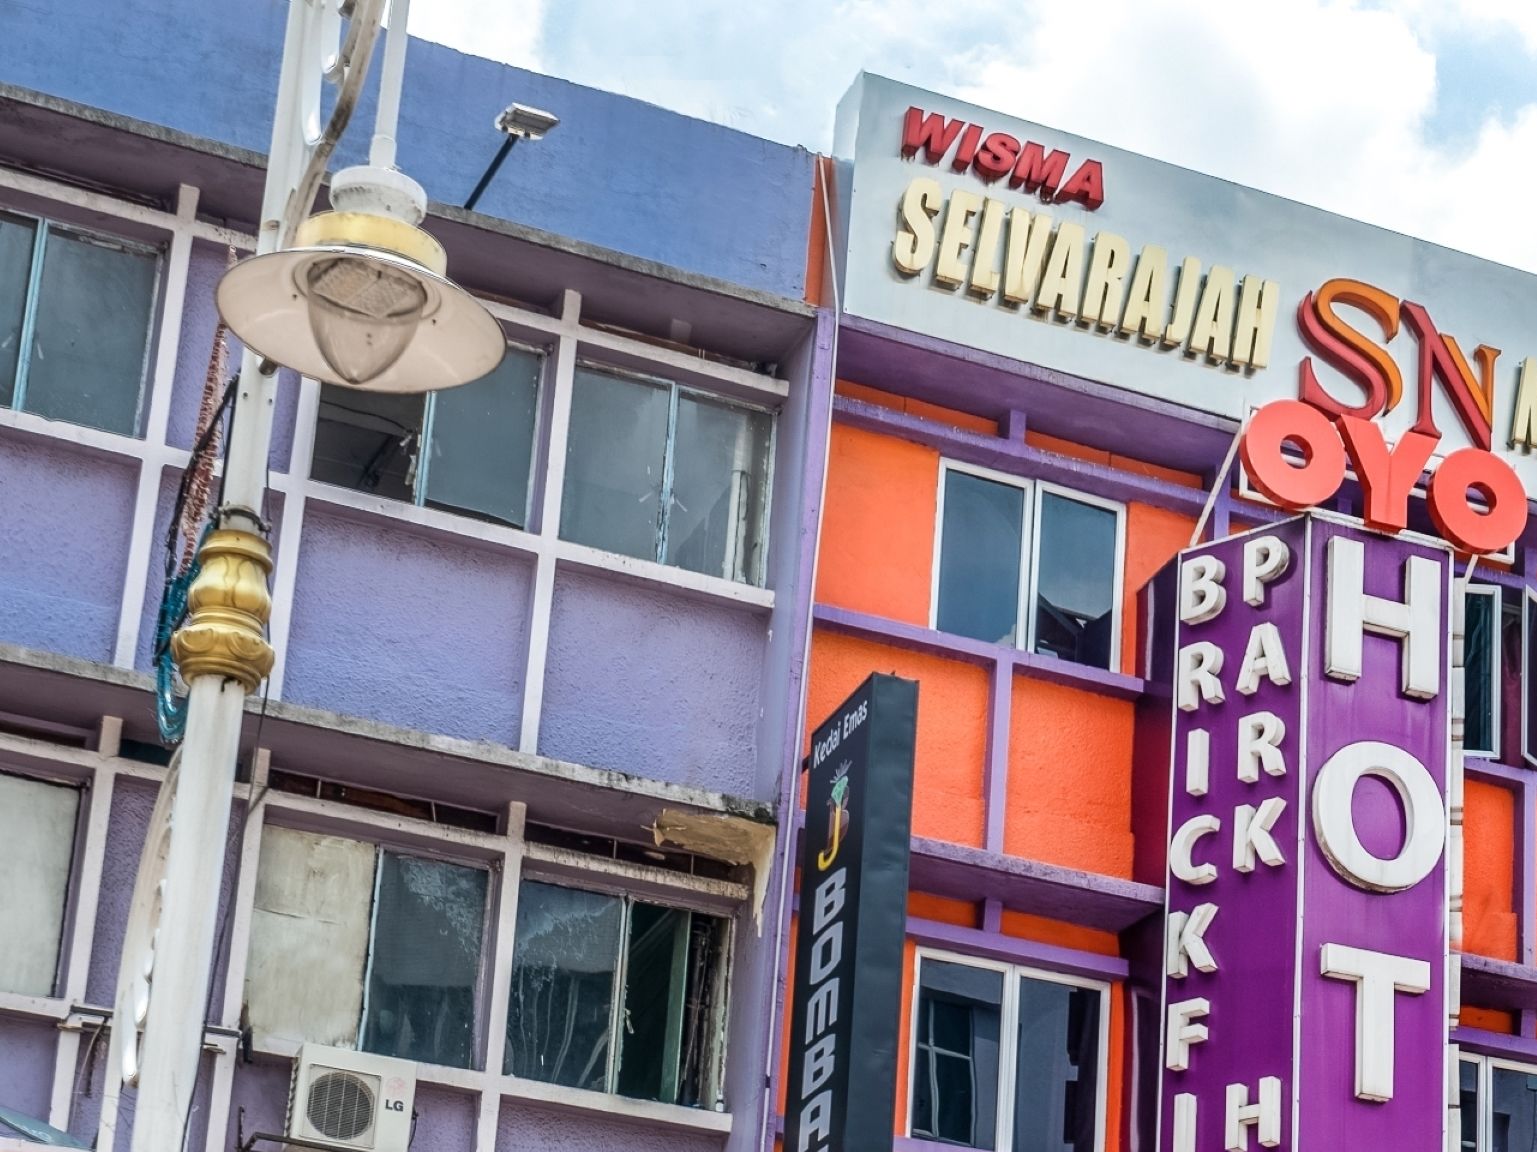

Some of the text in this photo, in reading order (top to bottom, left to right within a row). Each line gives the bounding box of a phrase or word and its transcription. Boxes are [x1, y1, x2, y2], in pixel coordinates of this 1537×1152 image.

[902, 106, 1106, 209] WISMA
[891, 176, 1279, 369] SELVARAJAH
[1297, 277, 1502, 453] SN
[1239, 398, 1528, 553] OYO
[812, 700, 868, 769] Kedai Emas
[1232, 535, 1291, 874] PARK
[385, 1098, 404, 1112] LG
